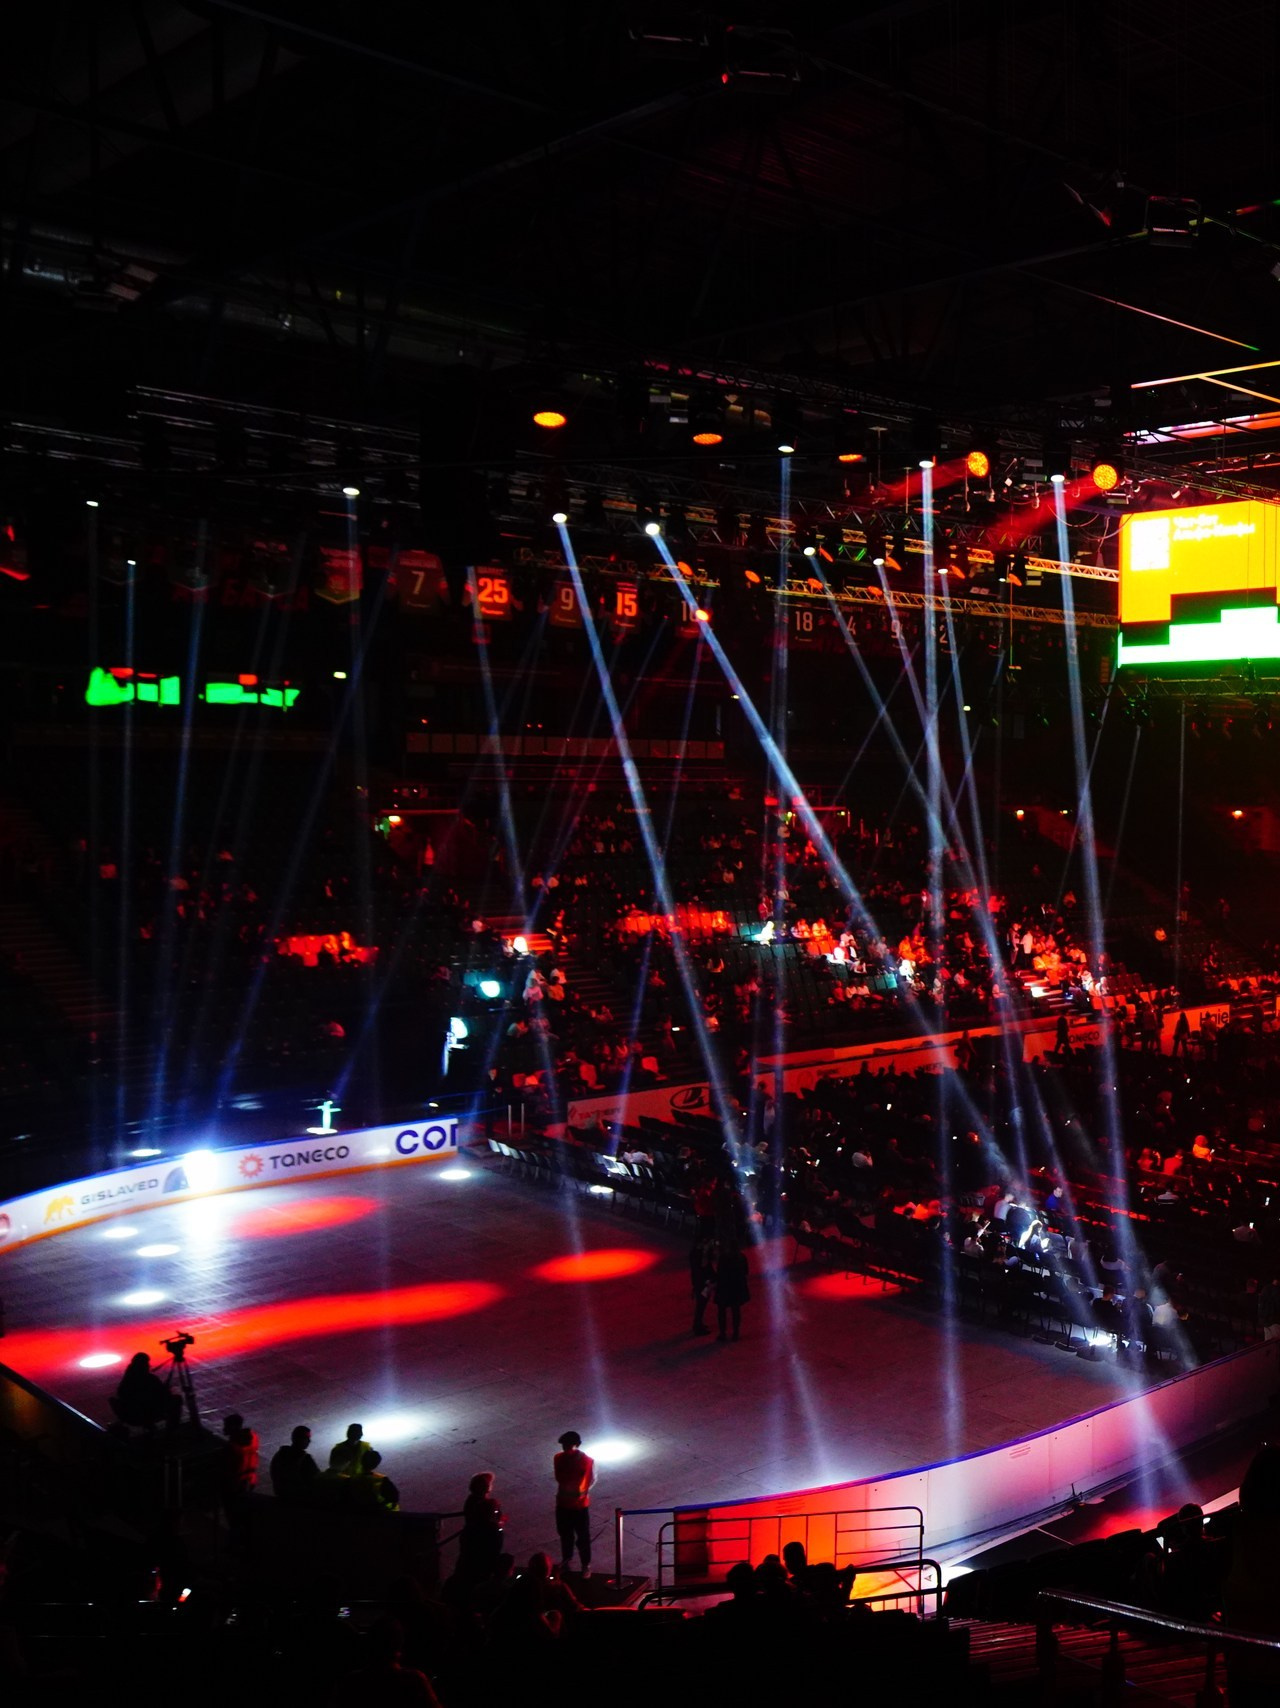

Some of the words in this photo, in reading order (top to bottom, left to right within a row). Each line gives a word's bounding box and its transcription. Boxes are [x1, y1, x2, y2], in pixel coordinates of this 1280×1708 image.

[412, 570, 425, 595] 7
[477, 577, 509, 604] 25
[560, 588, 574, 611] 9
[616, 592, 638, 617] 15
[794, 611, 813, 632] 18
[1068, 1030, 1101, 1044] ANECO
[269, 1145, 350, 1169] TANECO
[80, 1177, 159, 1205] GISLAVED
